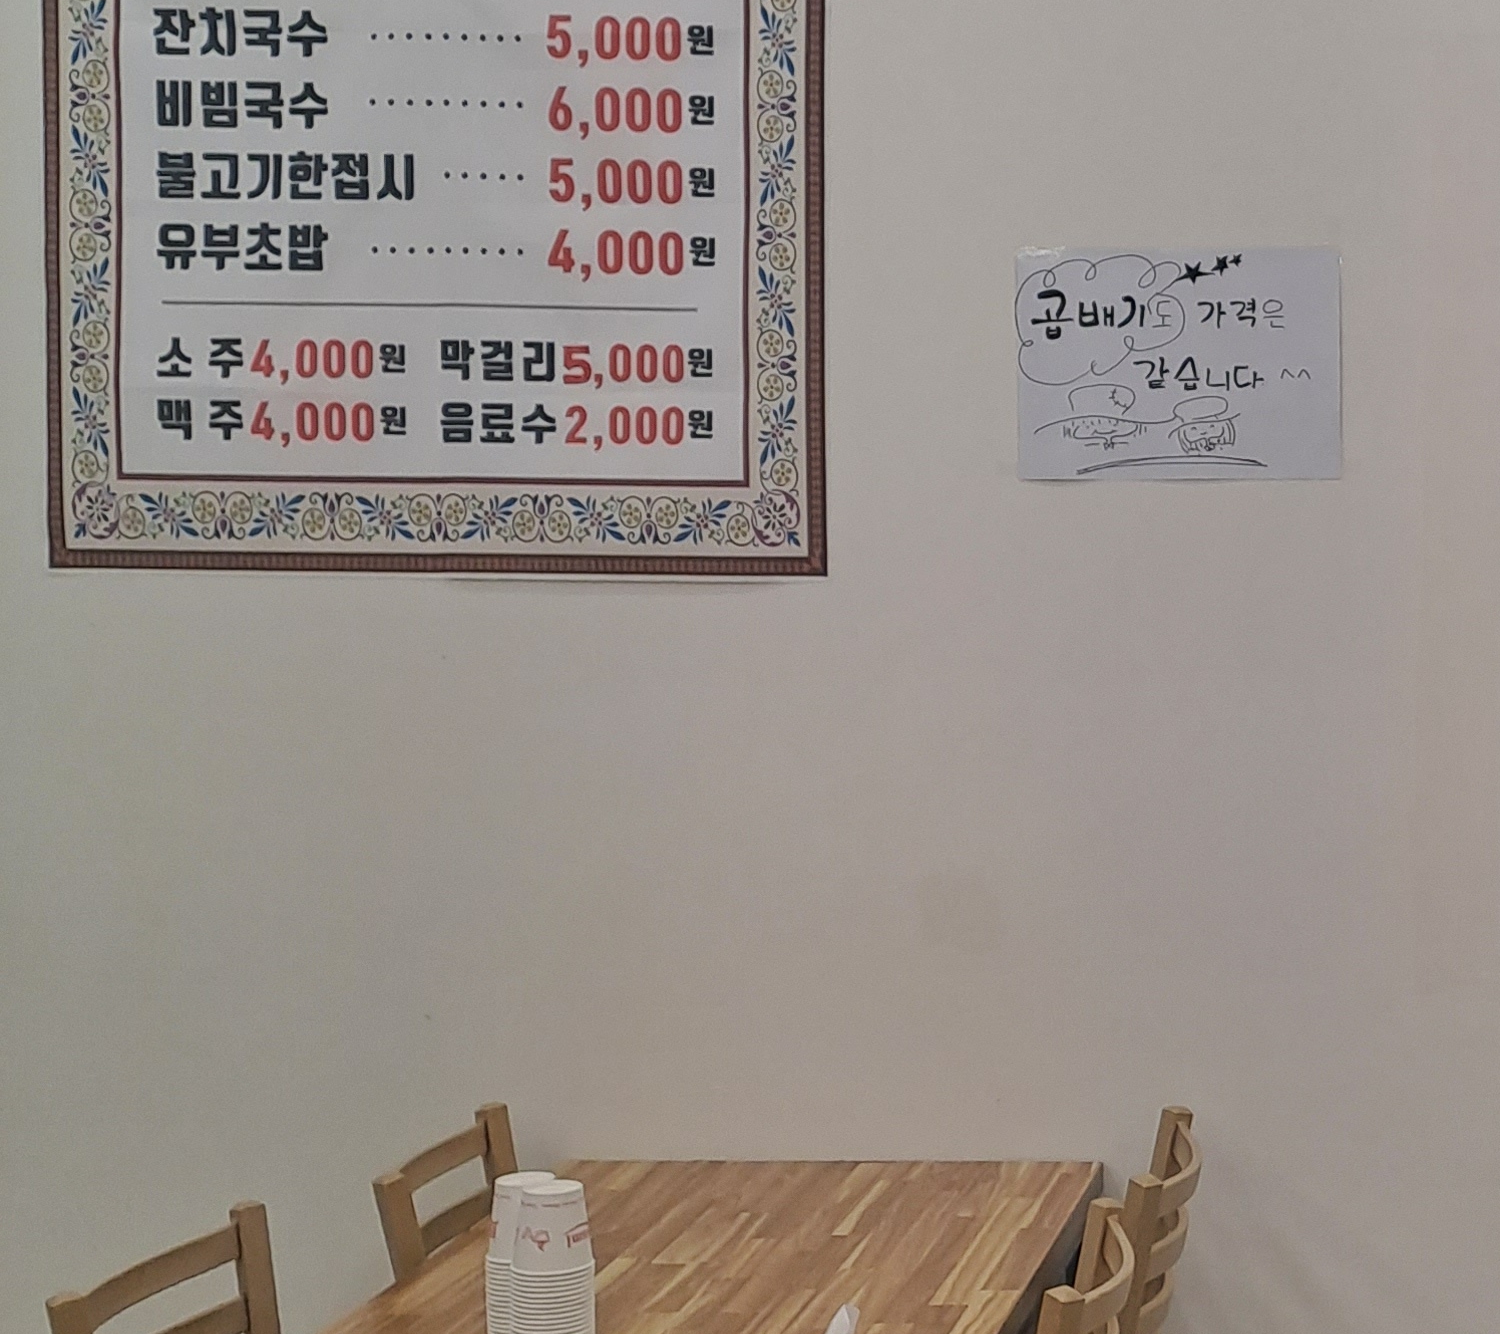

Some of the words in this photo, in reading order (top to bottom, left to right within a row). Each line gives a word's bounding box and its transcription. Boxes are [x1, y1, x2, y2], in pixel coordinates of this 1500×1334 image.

[152, 6, 329, 57] 잔치국수
[546, 14, 716, 68] 5,000원
[155, 78, 329, 130] 비빔국수
[548, 86, 716, 141] 6,000원
[156, 150, 415, 201] 불고기한접시
[549, 158, 716, 212] 5,000원
[156, 221, 329, 271] 유부초밥
[547, 228, 717, 284] 4,000원
[1196, 298, 1286, 330] 가격은
[440, 339, 556, 382] 막걸리
[562, 342, 714, 389] 5,000원
[440, 402, 557, 445] 음료수
[564, 405, 714, 451] 2,000원
